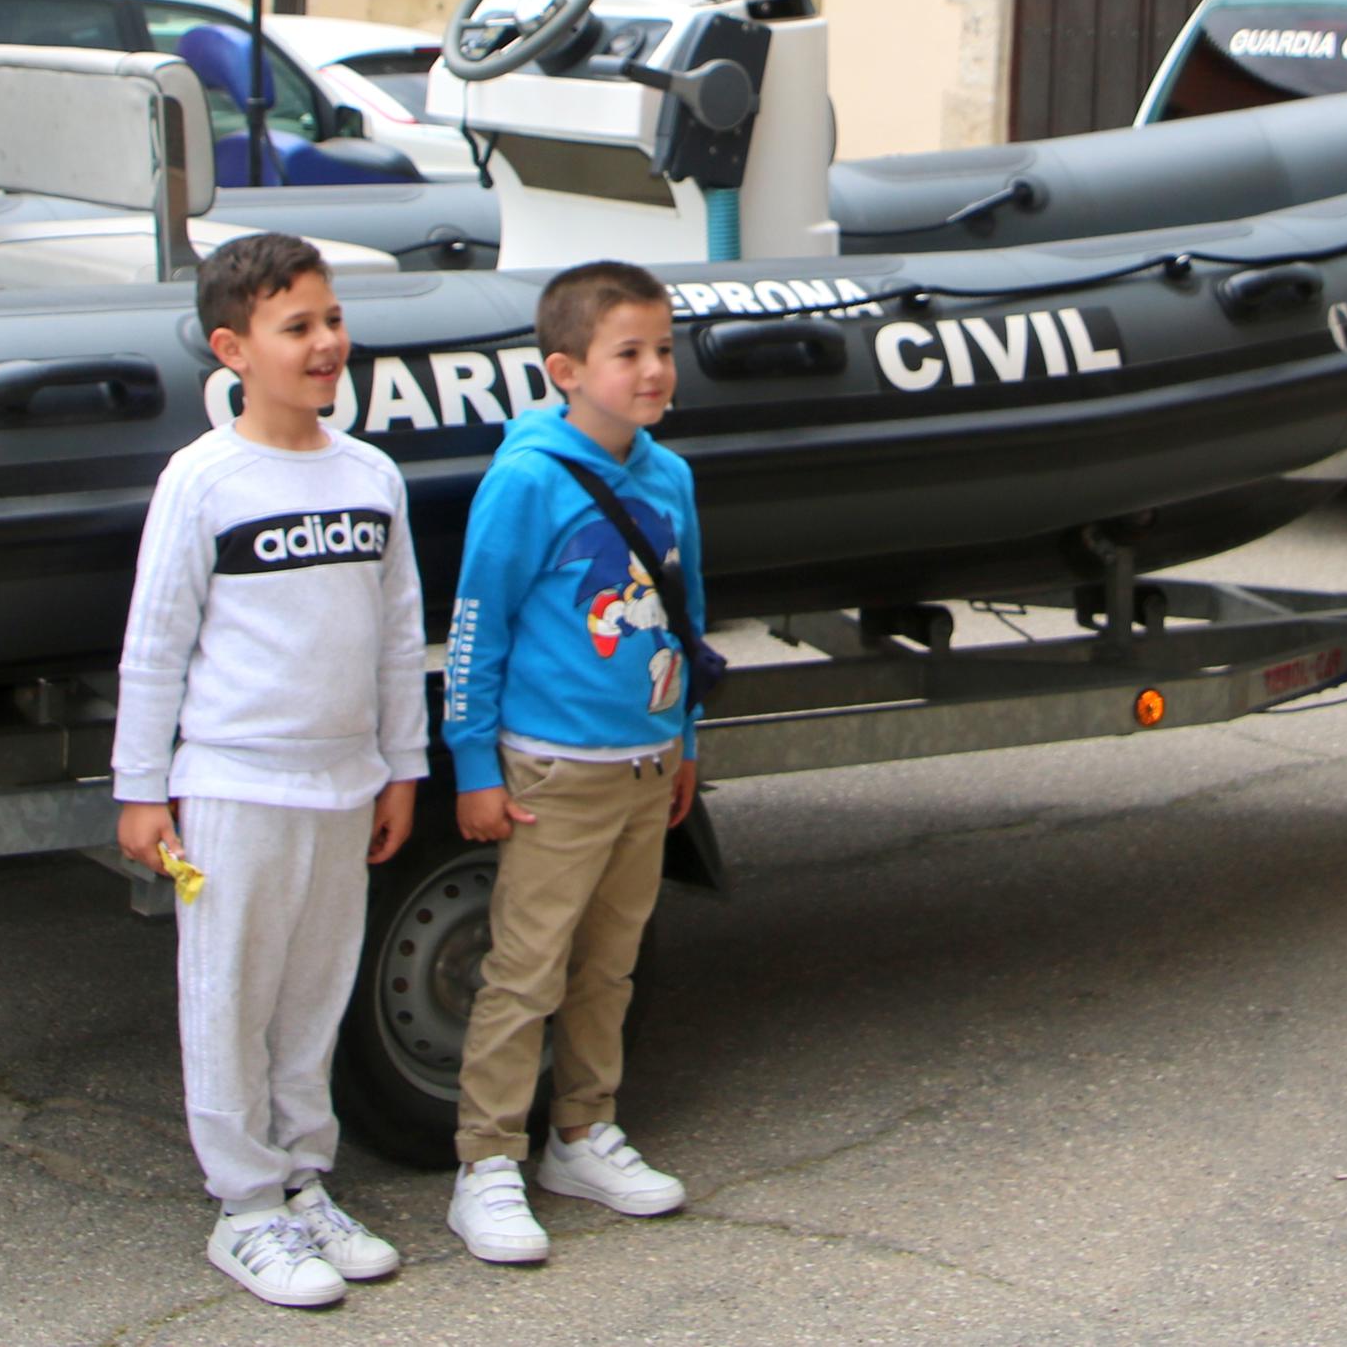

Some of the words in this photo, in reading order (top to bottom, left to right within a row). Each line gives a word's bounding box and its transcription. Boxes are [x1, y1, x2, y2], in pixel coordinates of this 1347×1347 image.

[1229, 28, 1337, 60] GUARDIA
[668, 276, 884, 320] EPRONA
[874, 307, 1122, 393] CIVIL
[253, 513, 386, 562] adidas
